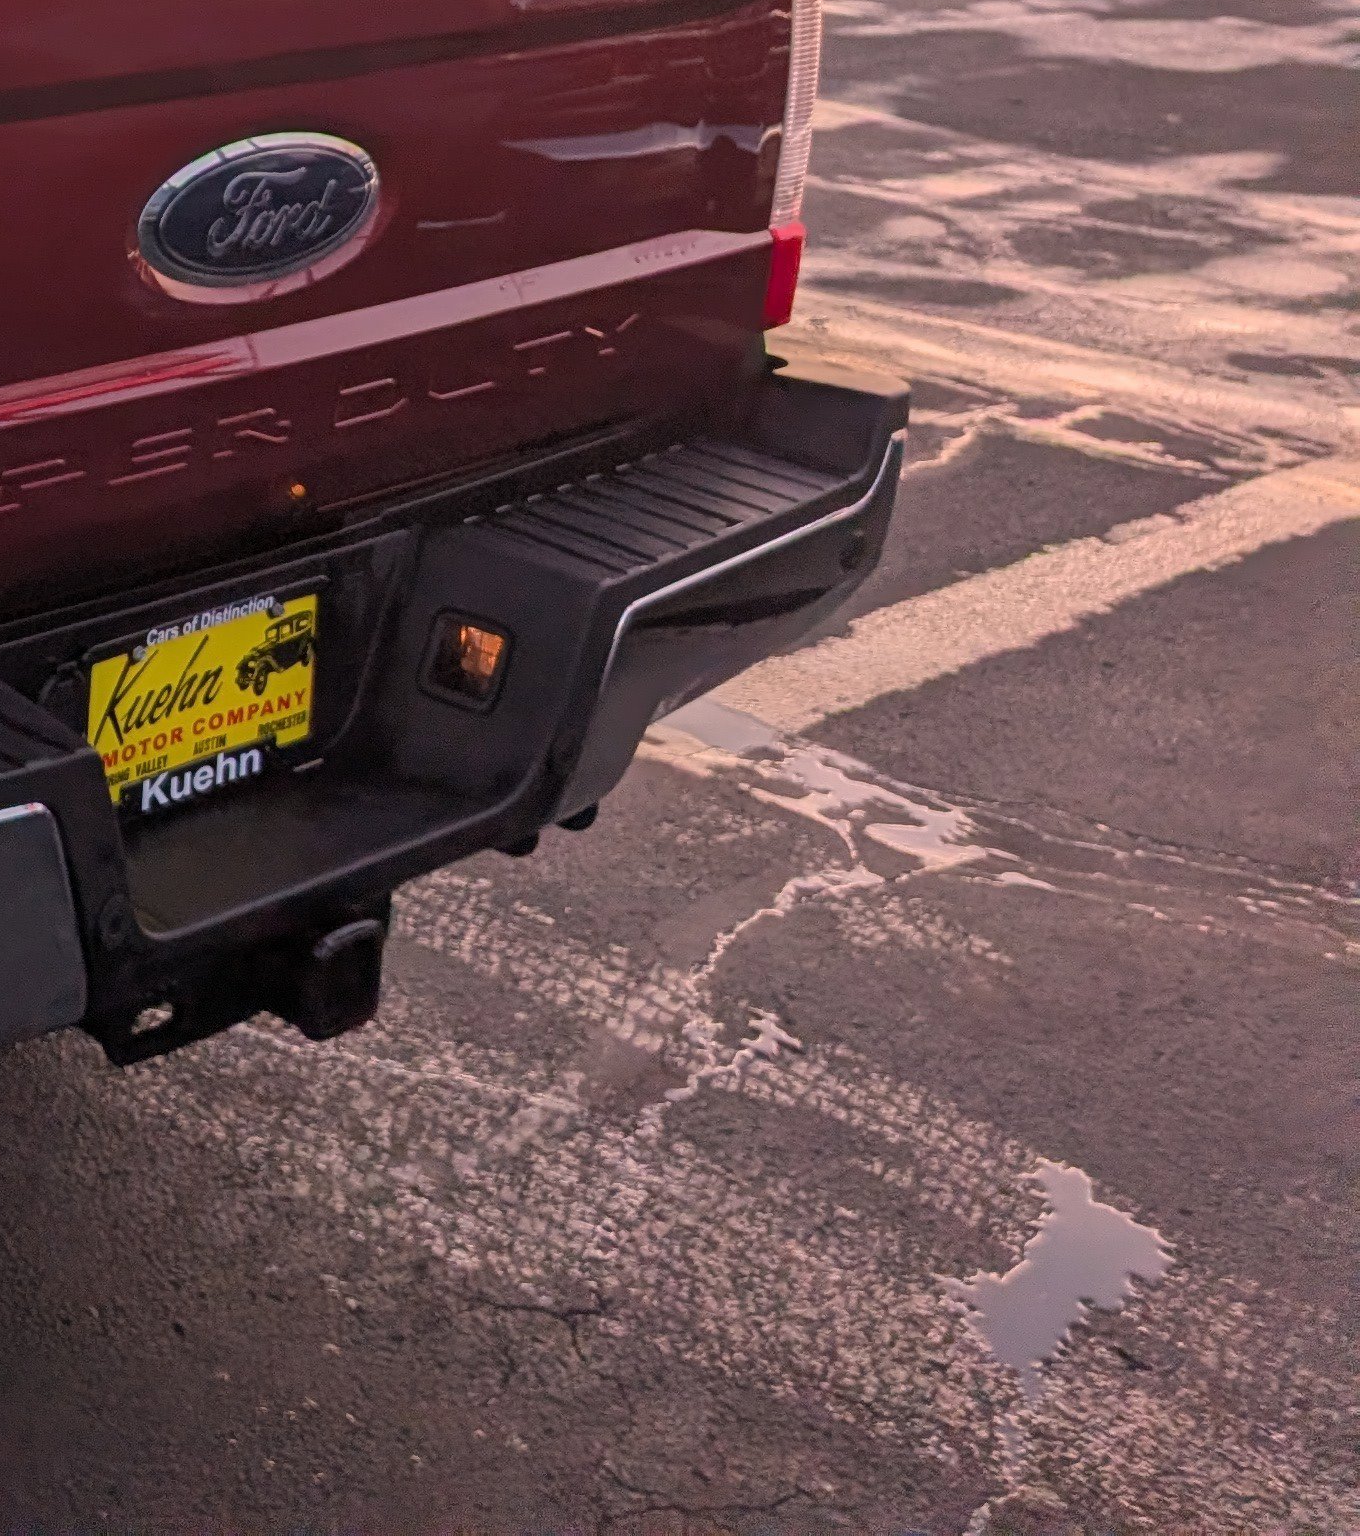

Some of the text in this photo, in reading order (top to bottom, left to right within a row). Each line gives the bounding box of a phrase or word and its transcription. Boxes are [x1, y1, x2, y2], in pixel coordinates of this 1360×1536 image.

[206, 166, 337, 258] Ford
[334, 312, 640, 429] DUTY
[146, 595, 274, 646] Cars of Distinction
[93, 635, 224, 746] Kuehn
[101, 688, 307, 768] MOTOR COMPANY
[135, 754, 168, 777] VALLEY
[193, 734, 227, 756] AUSTIN
[141, 748, 263, 814] Kuehn
